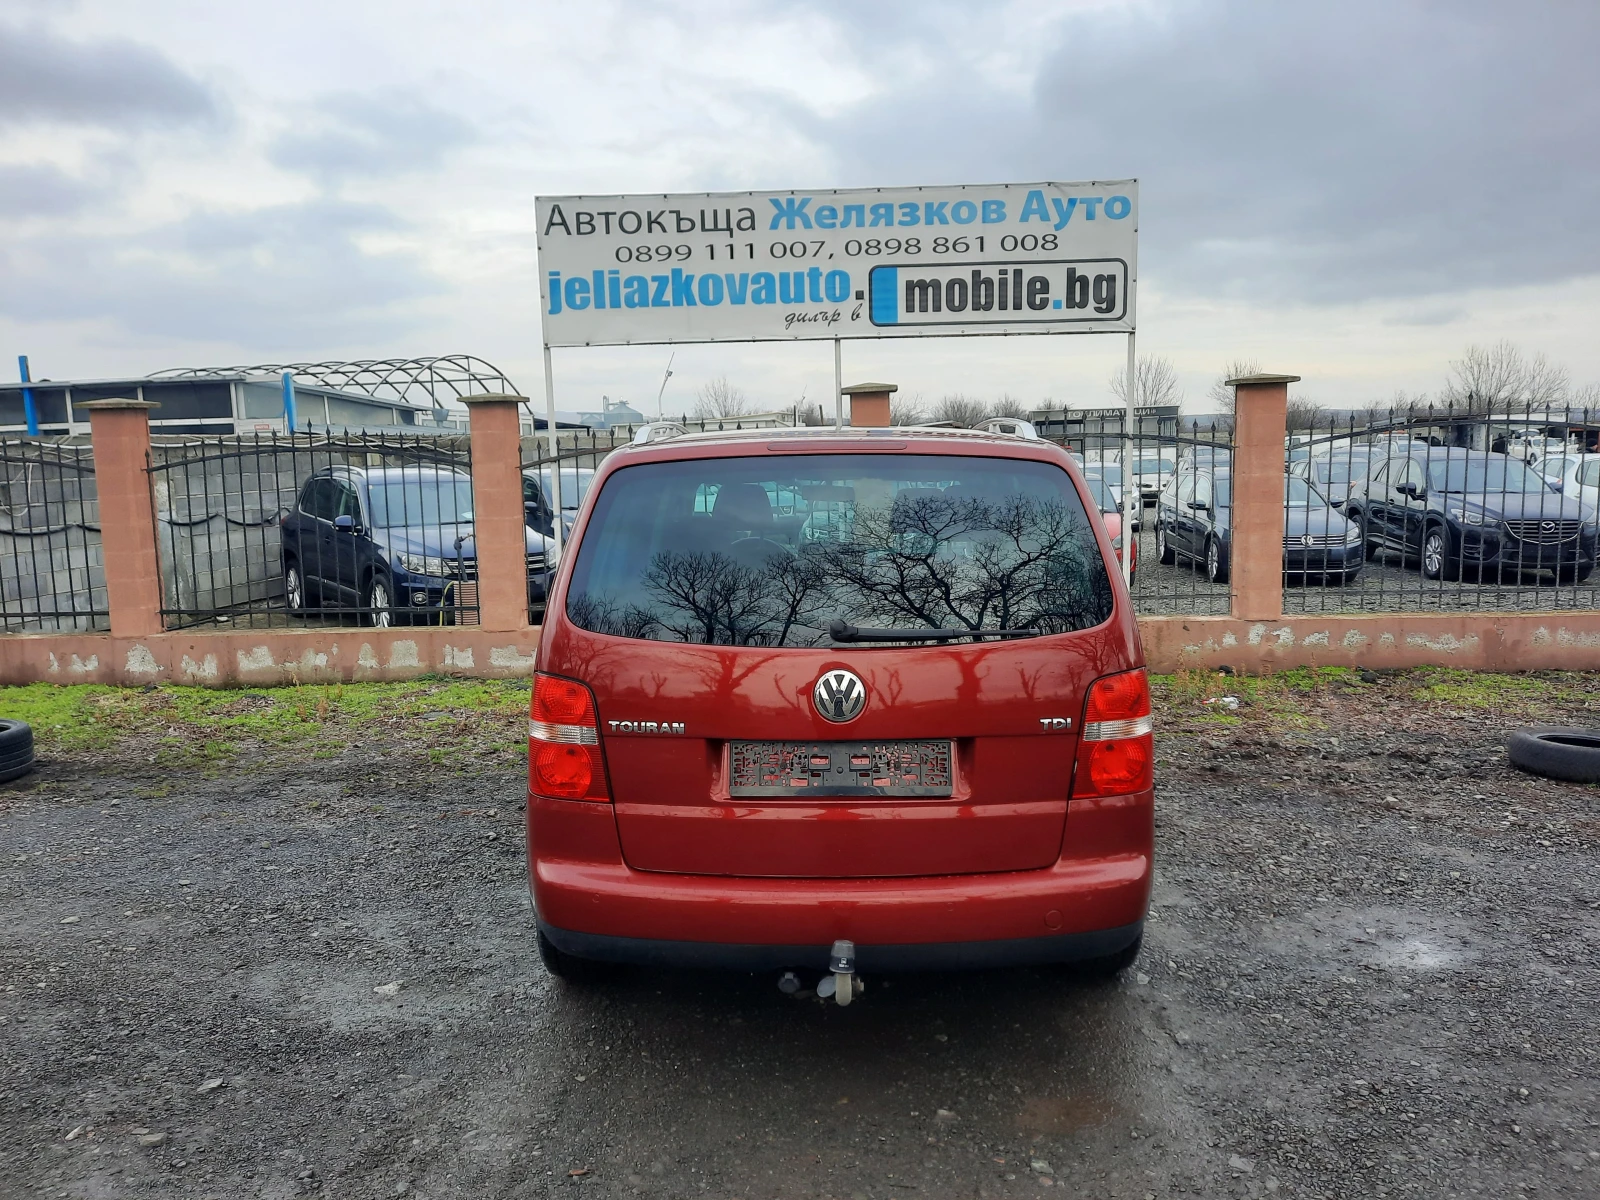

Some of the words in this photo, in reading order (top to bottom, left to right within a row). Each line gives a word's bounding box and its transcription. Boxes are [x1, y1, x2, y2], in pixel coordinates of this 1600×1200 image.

[544, 203, 756, 239] Автокъща
[768, 197, 1006, 230] Желязков
[1019, 189, 1132, 232] Ауто
[615, 244, 692, 262] 0899
[705, 242, 754, 260] 111
[769, 240, 834, 260] 007,
[844, 237, 922, 257] 0898
[932, 235, 985, 254] 861
[1000, 233, 1059, 252] 008
[905, 266, 1117, 314] mobile.bg
[784, 308, 841, 331] дилър
[850, 302, 863, 322] в
[608, 720, 685, 735] TOURAN
[1039, 717, 1072, 730] TDI
